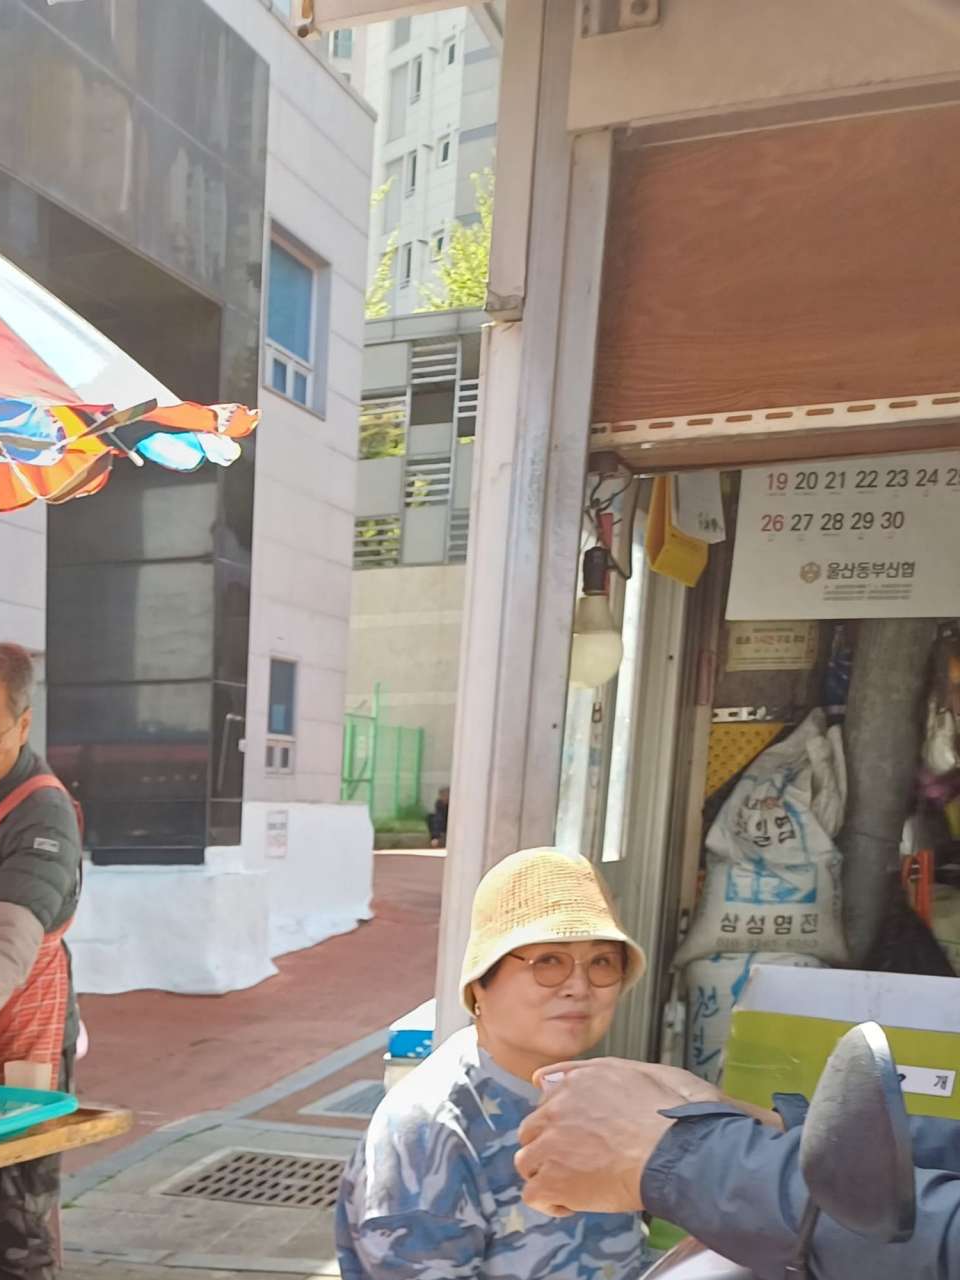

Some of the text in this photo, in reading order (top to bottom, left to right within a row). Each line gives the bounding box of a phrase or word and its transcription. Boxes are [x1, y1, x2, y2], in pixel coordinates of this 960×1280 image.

[768, 468, 960, 491] 19 20 21 22 23 24 2
[761, 511, 904, 532] 26 27 28 29 30
[826, 561, 916, 580] 울산동부신협
[720, 912, 819, 936] 삼성염전
